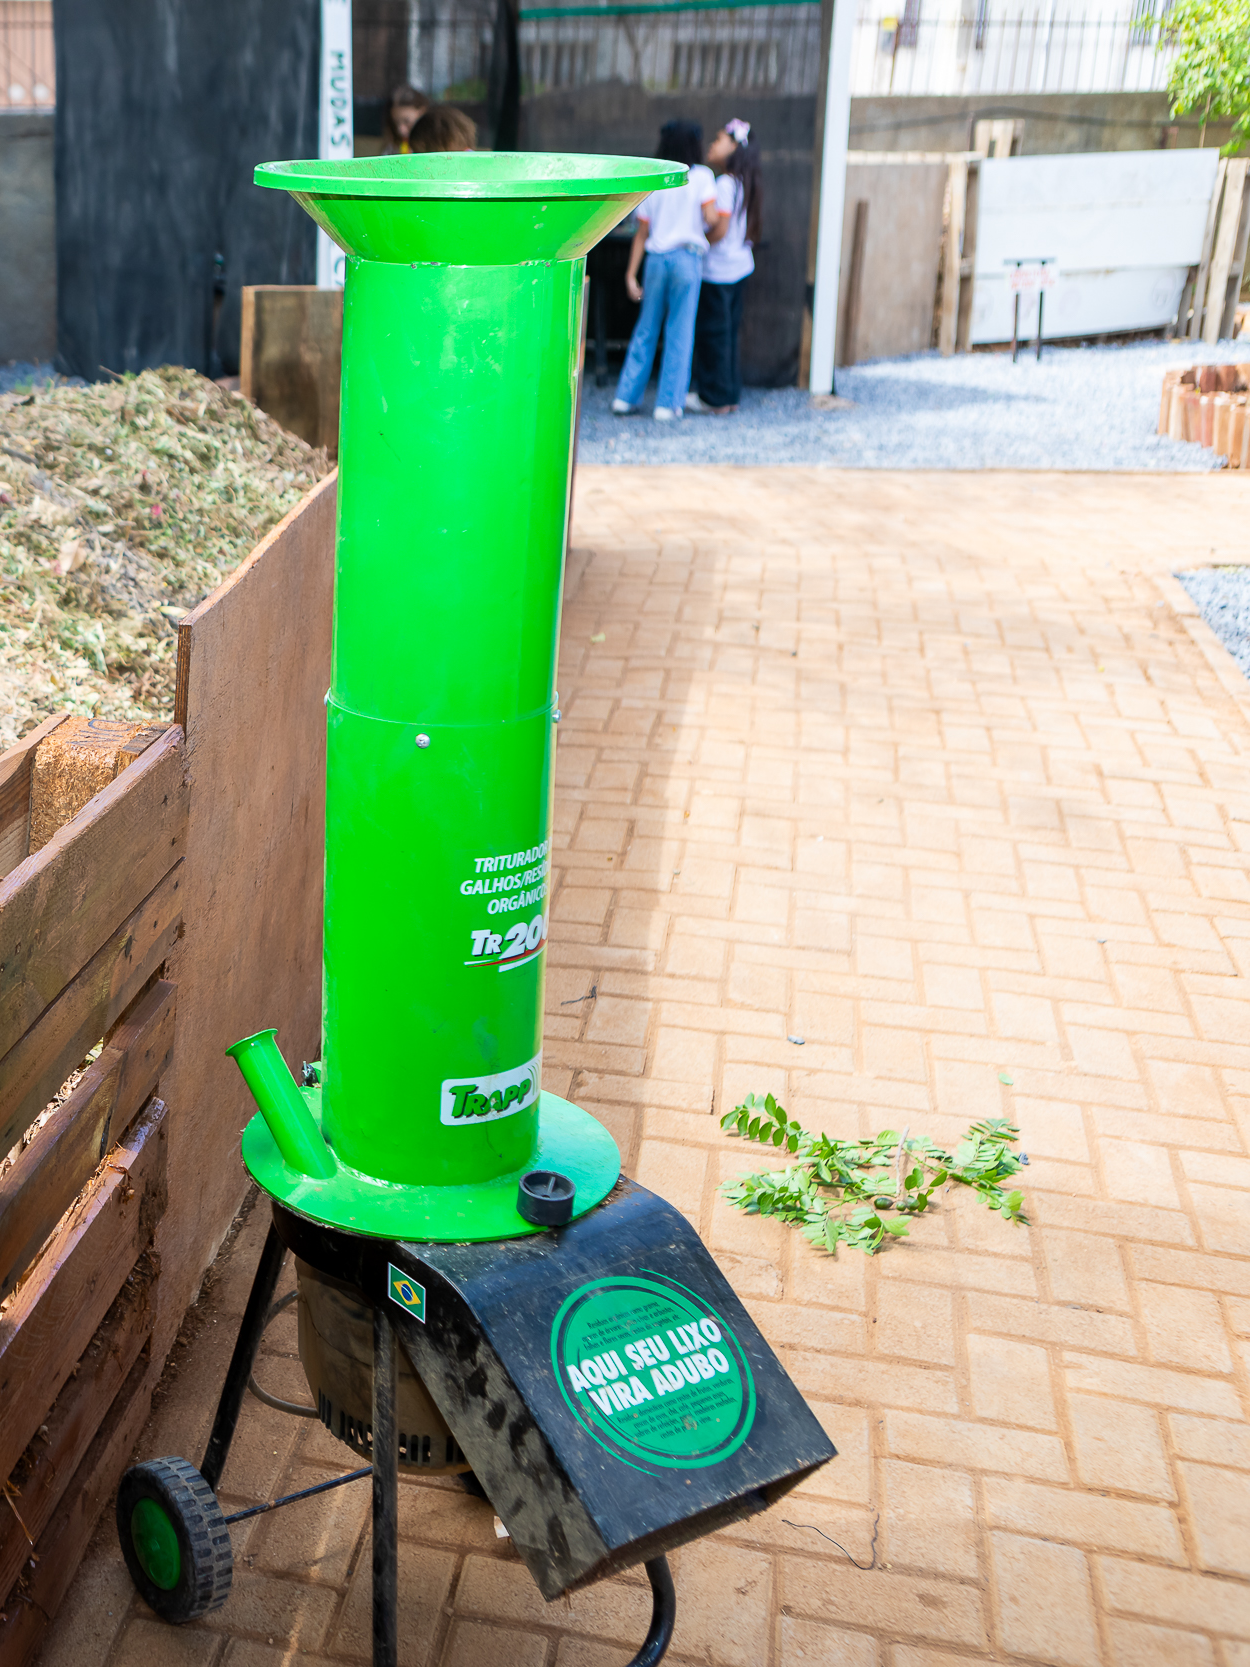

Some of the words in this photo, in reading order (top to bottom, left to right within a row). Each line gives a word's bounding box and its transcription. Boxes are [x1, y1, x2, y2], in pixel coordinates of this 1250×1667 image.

[330, 50, 349, 148] MUDAS
[474, 840, 548, 873] TRITURADOR
[449, 1078, 531, 1118] TRAPP
[566, 1350, 628, 1392] AQUI
[624, 1334, 671, 1371] SEU
[666, 1318, 722, 1355] LIXO
[589, 1376, 654, 1416] VIRA
[650, 1348, 730, 1396] ADUBO
